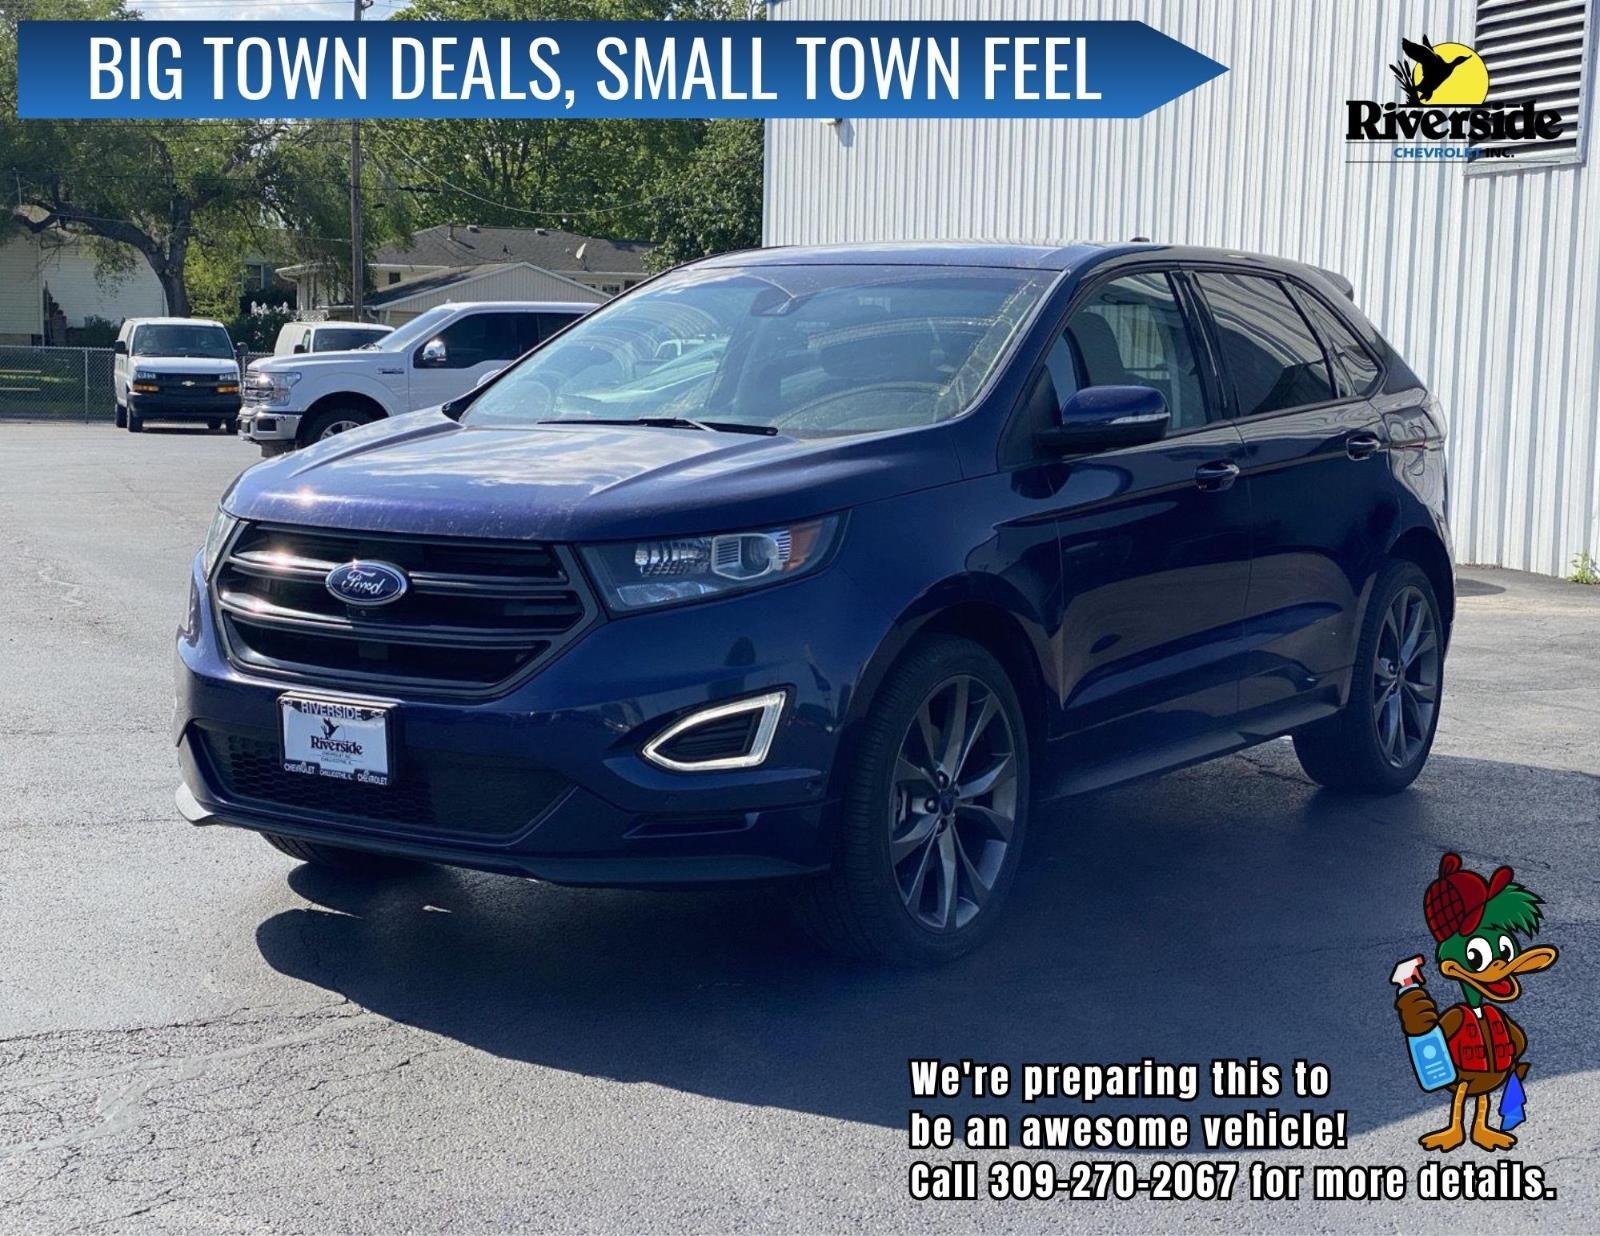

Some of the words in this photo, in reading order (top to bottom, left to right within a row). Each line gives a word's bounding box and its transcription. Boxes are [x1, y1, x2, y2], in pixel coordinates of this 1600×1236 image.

[341, 569, 385, 594] Ford
[301, 701, 362, 719] RIVERSIDE
[311, 735, 363, 755] Riverside
